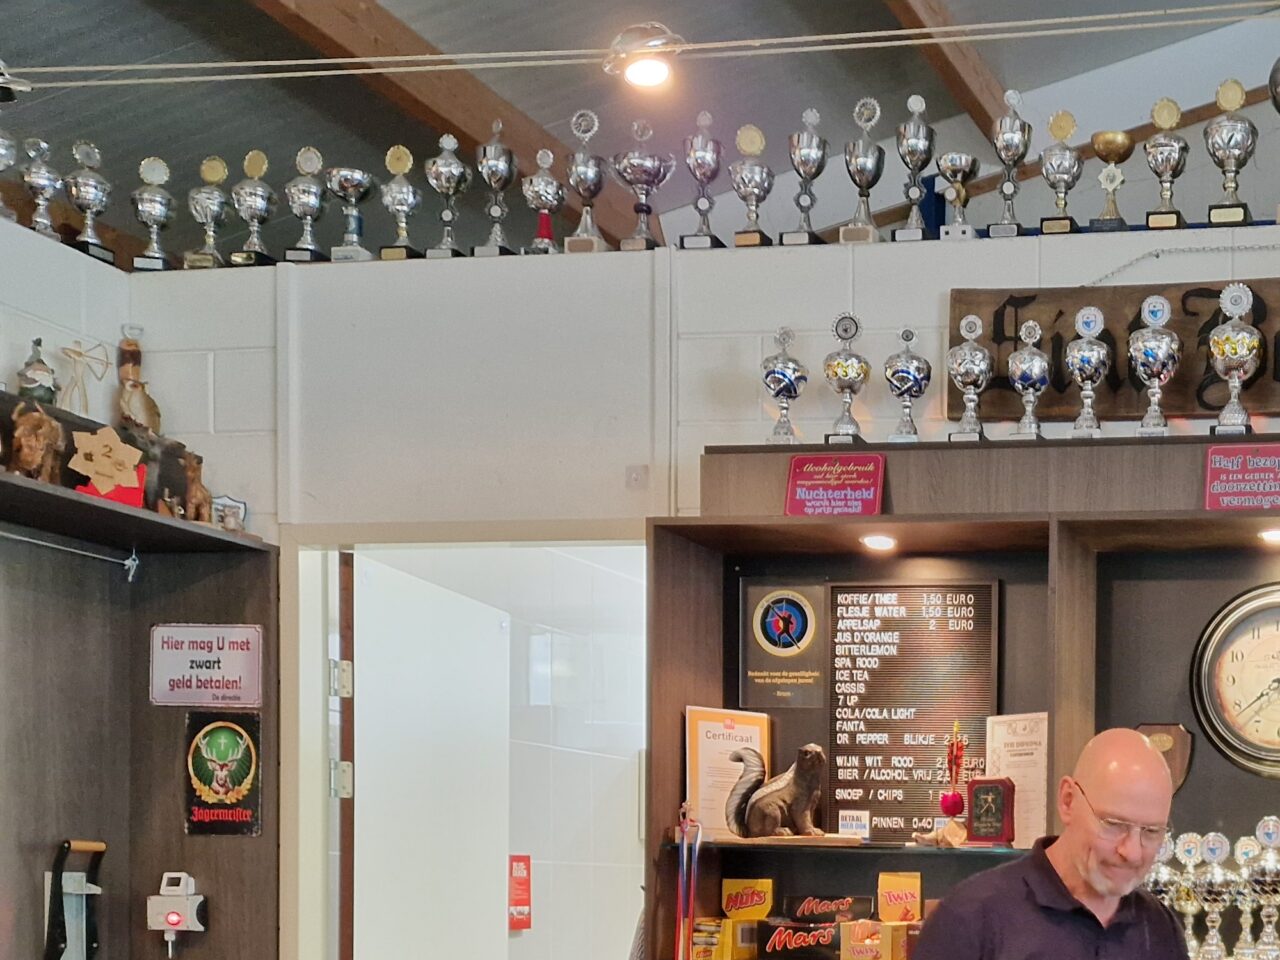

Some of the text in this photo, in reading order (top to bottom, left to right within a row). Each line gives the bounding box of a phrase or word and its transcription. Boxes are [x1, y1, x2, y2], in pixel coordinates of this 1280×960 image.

[1212, 455, 1242, 470] Half
[1245, 472, 1274, 480] GEBREK
[796, 486, 875, 500] Nuchterheid
[923, 594, 942, 606] 1,50
[946, 594, 974, 604] EURO
[837, 606, 974, 618] FLESJE WATER 1,50 EURO
[837, 619, 974, 630] APPELSAP 2 EURO
[834, 632, 900, 643] JUS D'ORANGE
[1252, 628, 1261, 640] 11
[161, 636, 250, 653] Hier mag U met
[835, 644, 897, 656] BITTERLEMON
[1231, 650, 1244, 663] 10
[189, 656, 222, 670] zwart
[834, 658, 878, 668] SPA ROOD
[836, 670, 869, 681] ICE TEA
[1226, 674, 1236, 686] 9
[168, 674, 242, 692] geld betalen!
[836, 683, 865, 694] CASSIS
[838, 696, 858, 706] 7 UP
[1233, 700, 1242, 711] 8
[836, 708, 916, 720] COLA/COLA LIGHT
[836, 721, 865, 732] FANTA
[1254, 720, 1261, 734] 7
[705, 730, 753, 743] Certificaat
[836, 734, 936, 745] DR PEPPER BLIKJE
[836, 756, 985, 768] WIJN WIT ROOD EURO
[838, 769, 859, 780] BIER
[912, 770, 932, 781] VRIJ
[836, 789, 863, 800] SNOEP
[878, 790, 903, 800] CHIPS
[872, 816, 904, 828] PINNEN
[796, 896, 852, 918] Mars
[766, 926, 836, 952] Mars
